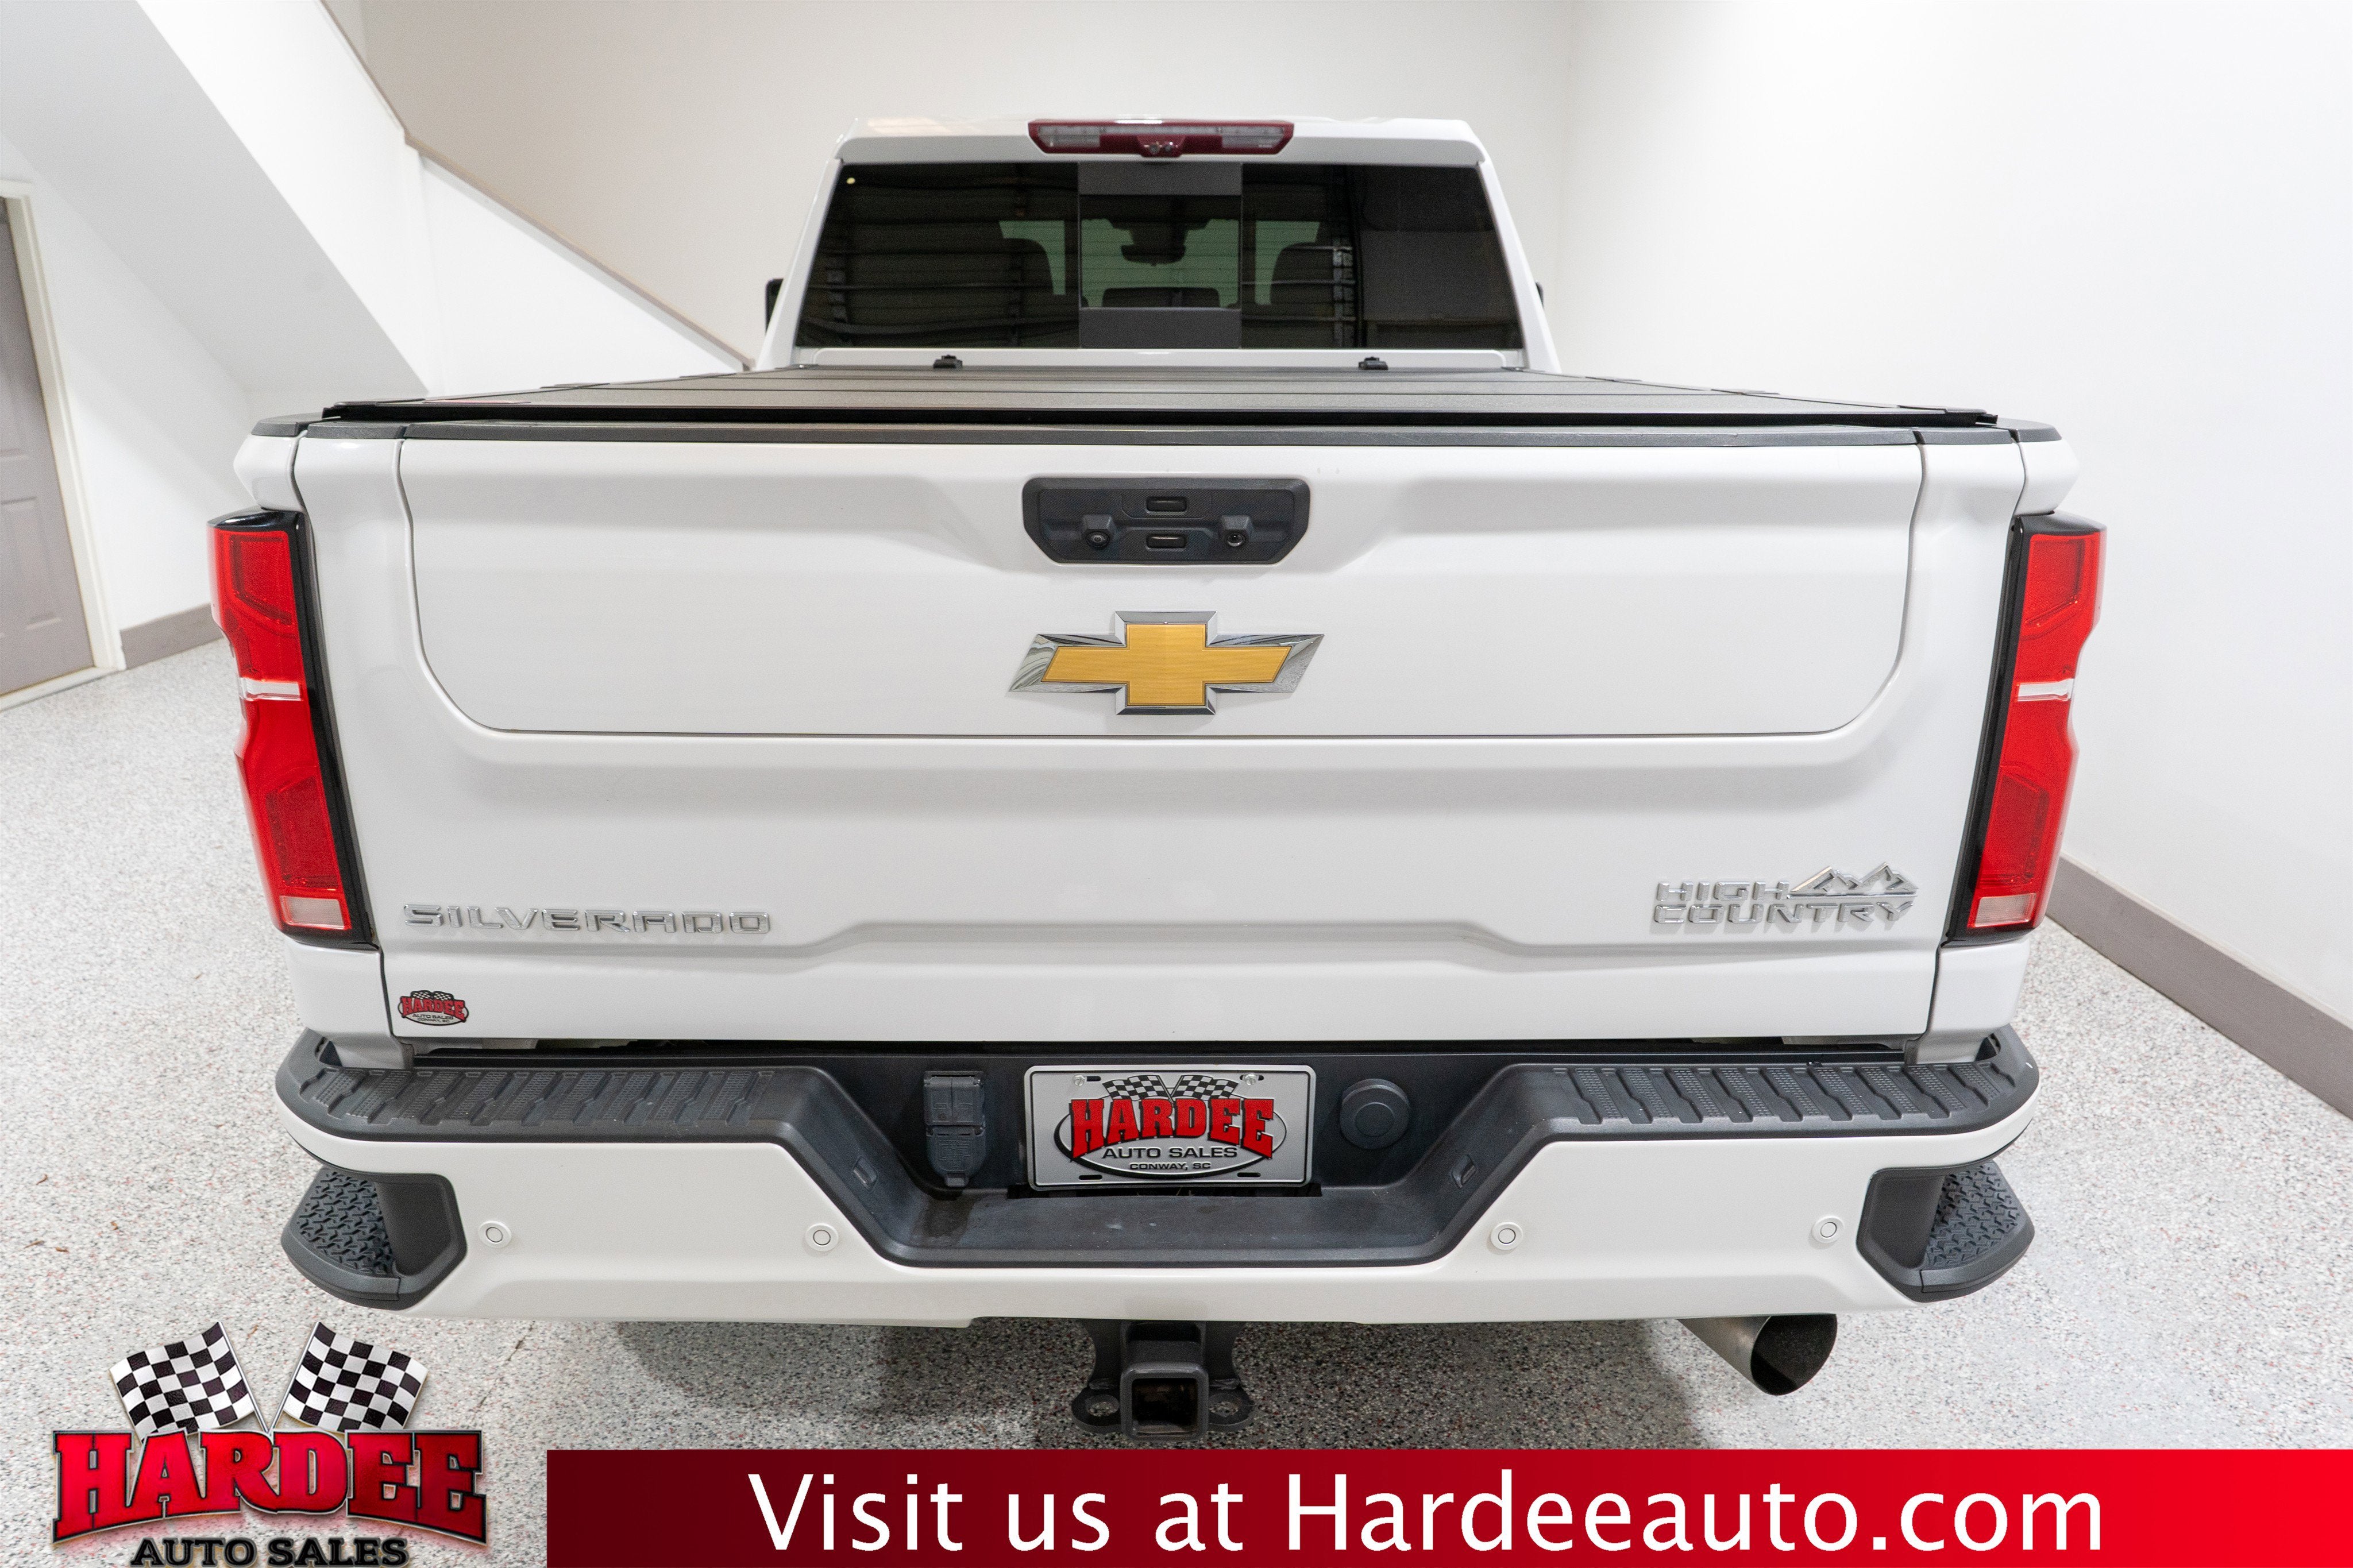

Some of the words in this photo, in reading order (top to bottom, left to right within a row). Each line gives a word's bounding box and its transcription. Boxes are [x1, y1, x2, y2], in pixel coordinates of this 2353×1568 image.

[1656, 880, 1789, 901] HIGH
[403, 903, 770, 934] SILVERADO
[1654, 902, 1914, 924] COUNTRY
[400, 997, 465, 1021] HARDEE
[1069, 1098, 1275, 1159] HARDEE
[1102, 1147, 1161, 1158] AUTO
[1168, 1147, 1237, 1158] SALES
[1129, 1163, 1188, 1171] CONWAY,
